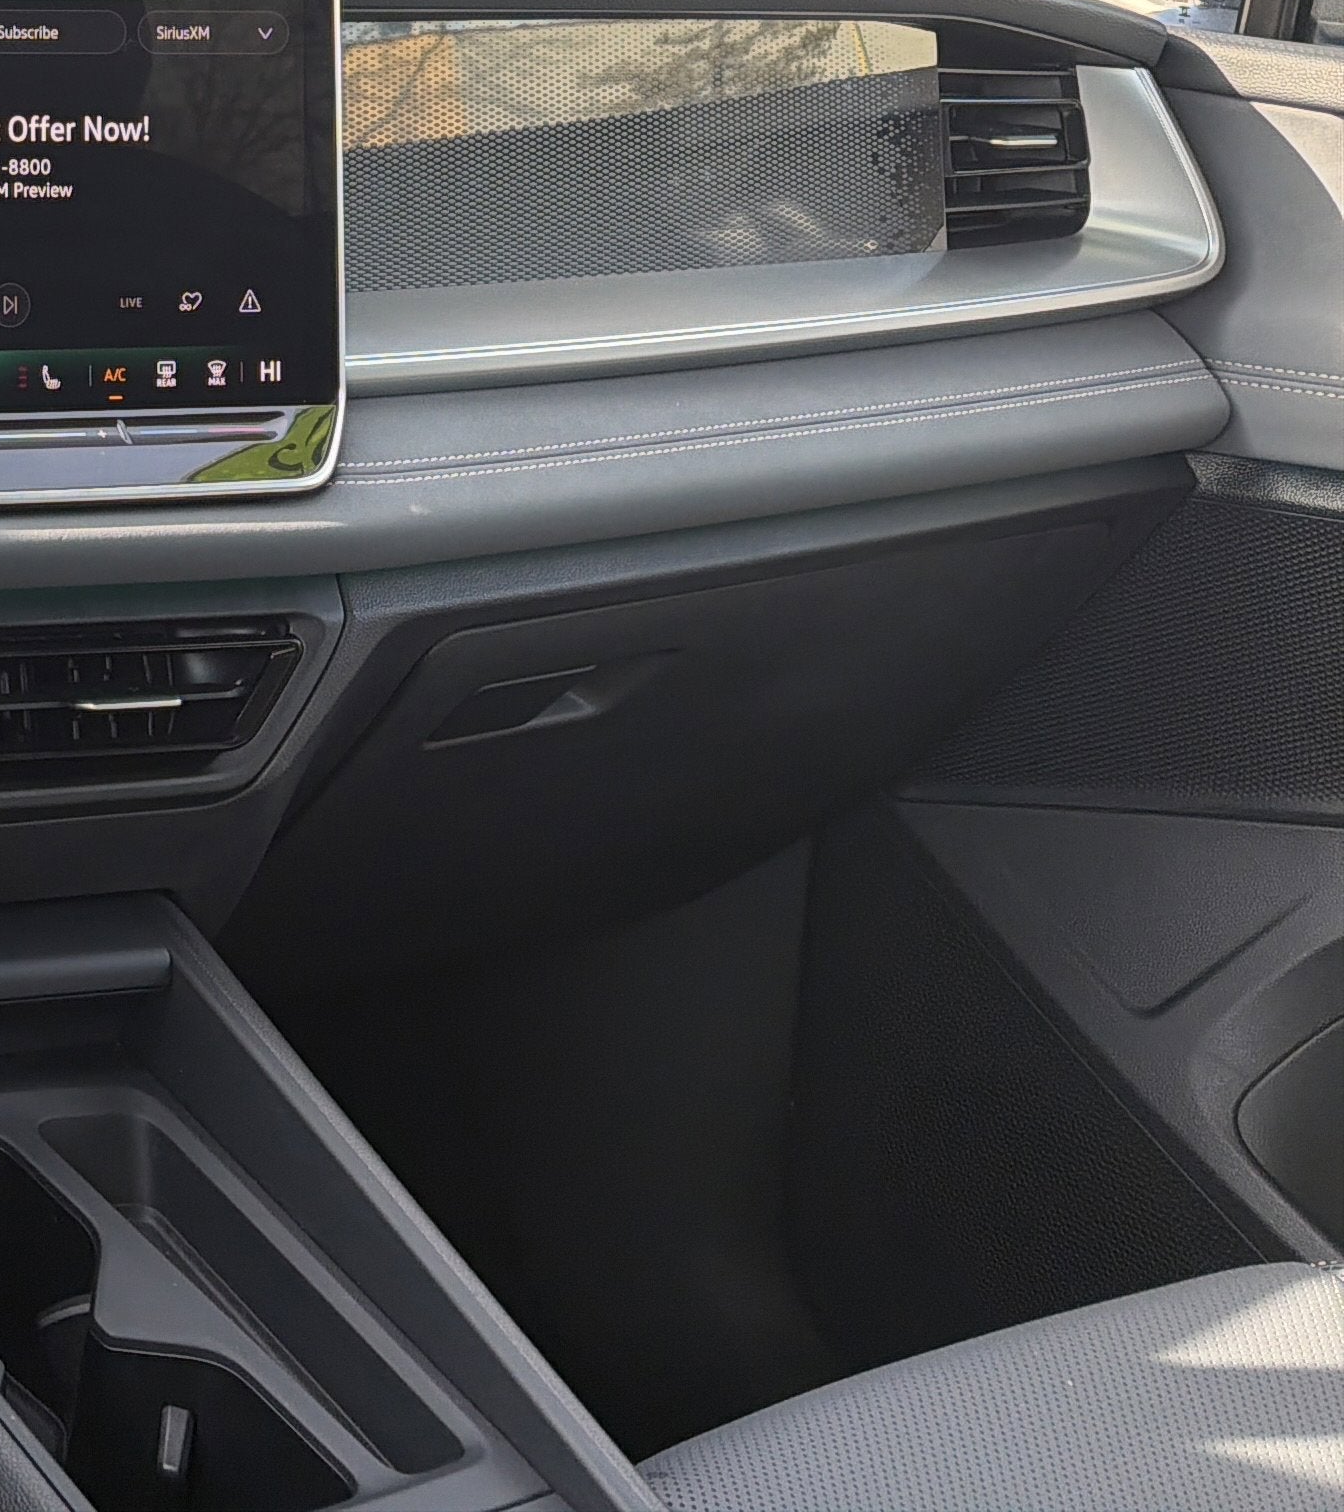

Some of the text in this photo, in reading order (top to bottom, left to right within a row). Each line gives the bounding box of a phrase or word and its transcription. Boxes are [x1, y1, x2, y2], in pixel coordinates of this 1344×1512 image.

[156, 25, 211, 41] SiriusXM
[7, 114, 77, 143] Offer
[83, 114, 151, 143] Now!
[13, 181, 73, 199] Preview
[119, 296, 143, 309] LIVE
[103, 367, 128, 383] A/C
[260, 360, 282, 382] HI
[156, 377, 177, 388] REAR
[207, 376, 227, 387] MAX
